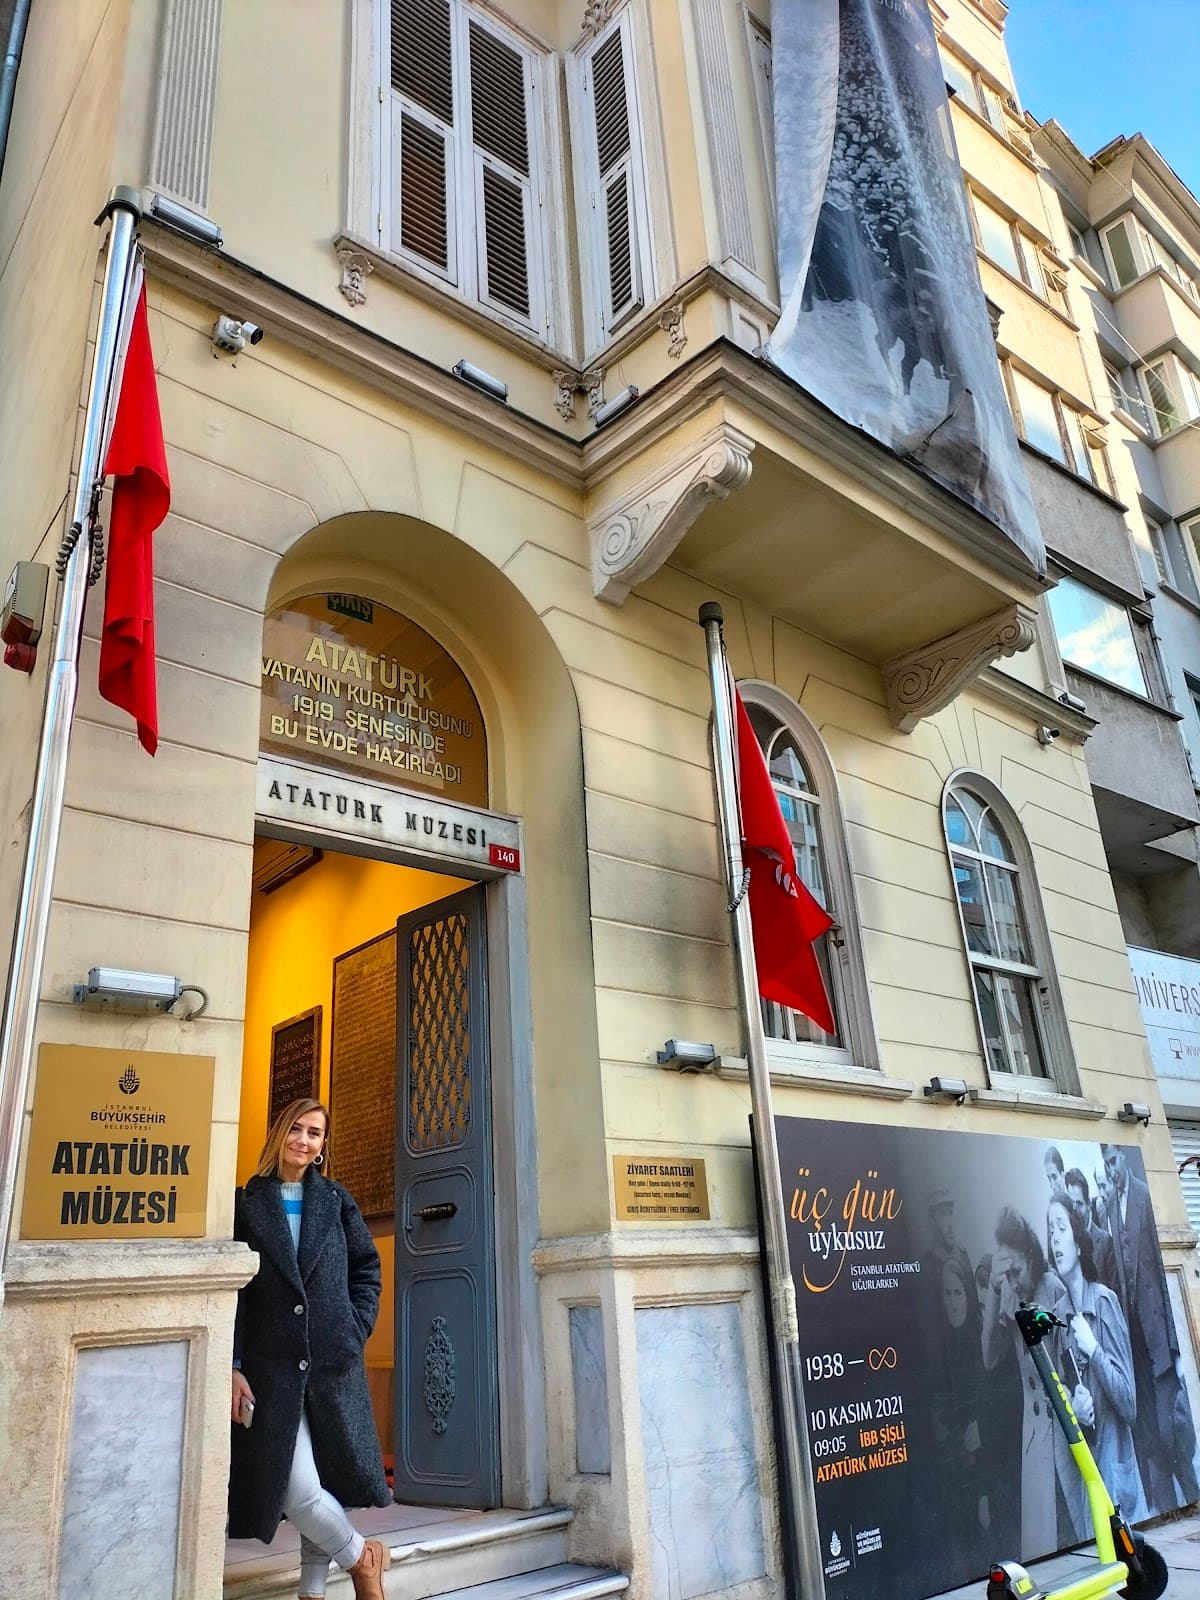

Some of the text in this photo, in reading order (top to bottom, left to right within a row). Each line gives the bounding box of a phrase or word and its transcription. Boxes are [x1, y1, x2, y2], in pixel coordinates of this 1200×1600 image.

[305, 635, 435, 701] ATATÜRK
[262, 656, 473, 738] VATANIN KURTULUŞUNU
[293, 694, 446, 754] 1919 SENESİNDE
[271, 714, 462, 785] BU EVDE HAZIRLADI
[268, 780, 488, 849] ATATÜRK MÜZESİ
[497, 850, 515, 864] 140
[90, 1109, 166, 1126] BÜYÜKŞEHİR
[51, 1138, 191, 1176] ATATÜRK
[627, 1163, 694, 1177] ZİYARET SAATLERİ
[60, 1185, 177, 1225] MÜZESİ
[808, 1222, 886, 1260] uykusuz
[850, 1263, 884, 1276] İSTANBUL
[851, 1277, 899, 1291] UĞURLARKEN
[806, 1352, 845, 1381] 1938
[811, 1395, 903, 1432] 10 KASIM 2021
[814, 1420, 906, 1457] 09:05 İBB ŞİŞLİ
[816, 1443, 908, 1484] ATATÜRK MÜZESİ
